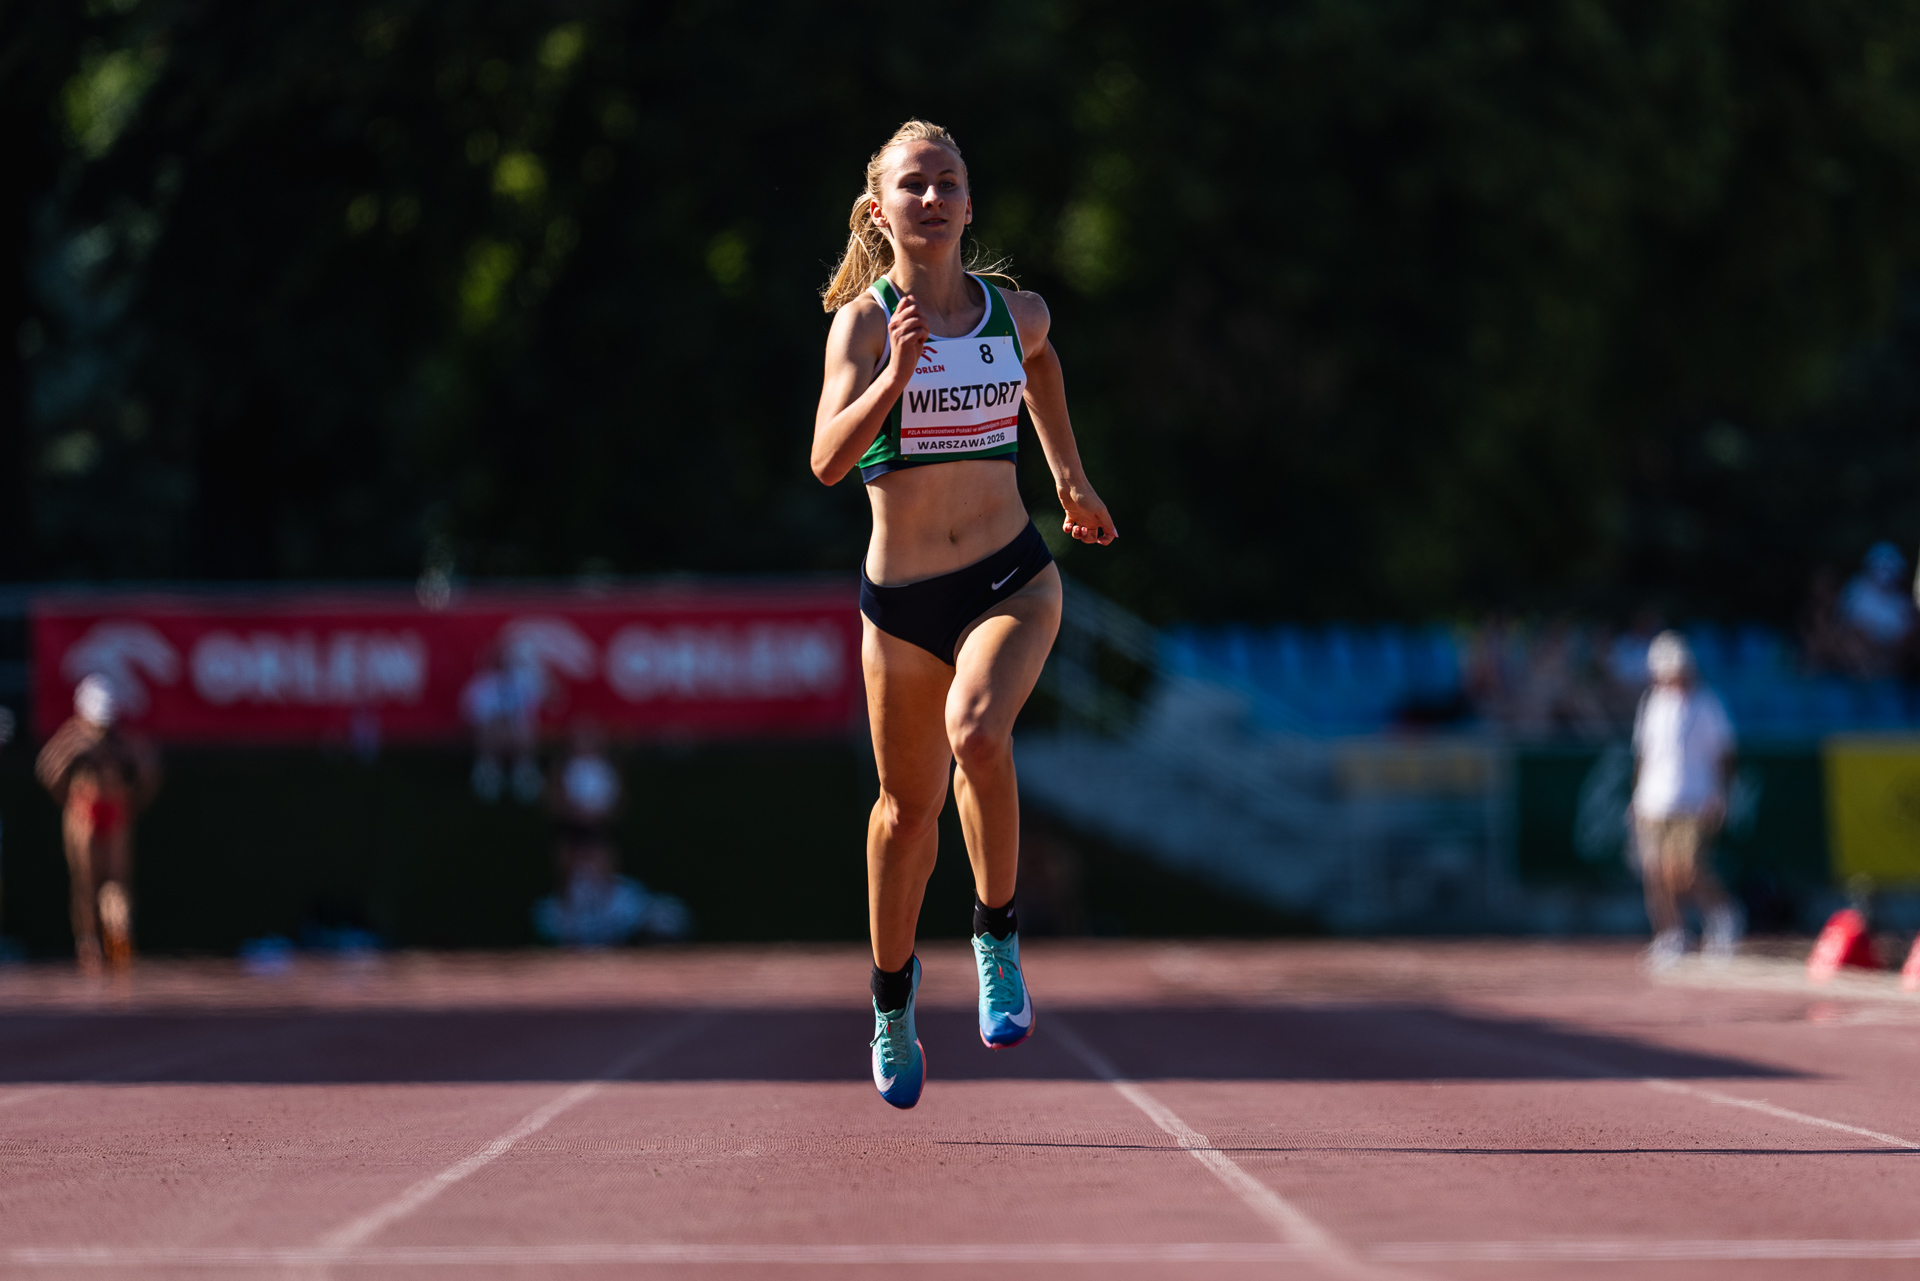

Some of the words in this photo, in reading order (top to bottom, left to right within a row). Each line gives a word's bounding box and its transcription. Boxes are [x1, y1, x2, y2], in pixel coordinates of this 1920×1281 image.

[979, 344, 994, 364] 8
[915, 364, 945, 375] ORLEN
[908, 380, 1021, 413] WIESZTORT
[917, 438, 986, 450] WARSZAWA
[986, 432, 1005, 444] 2026
[193, 628, 427, 704] ORLEN
